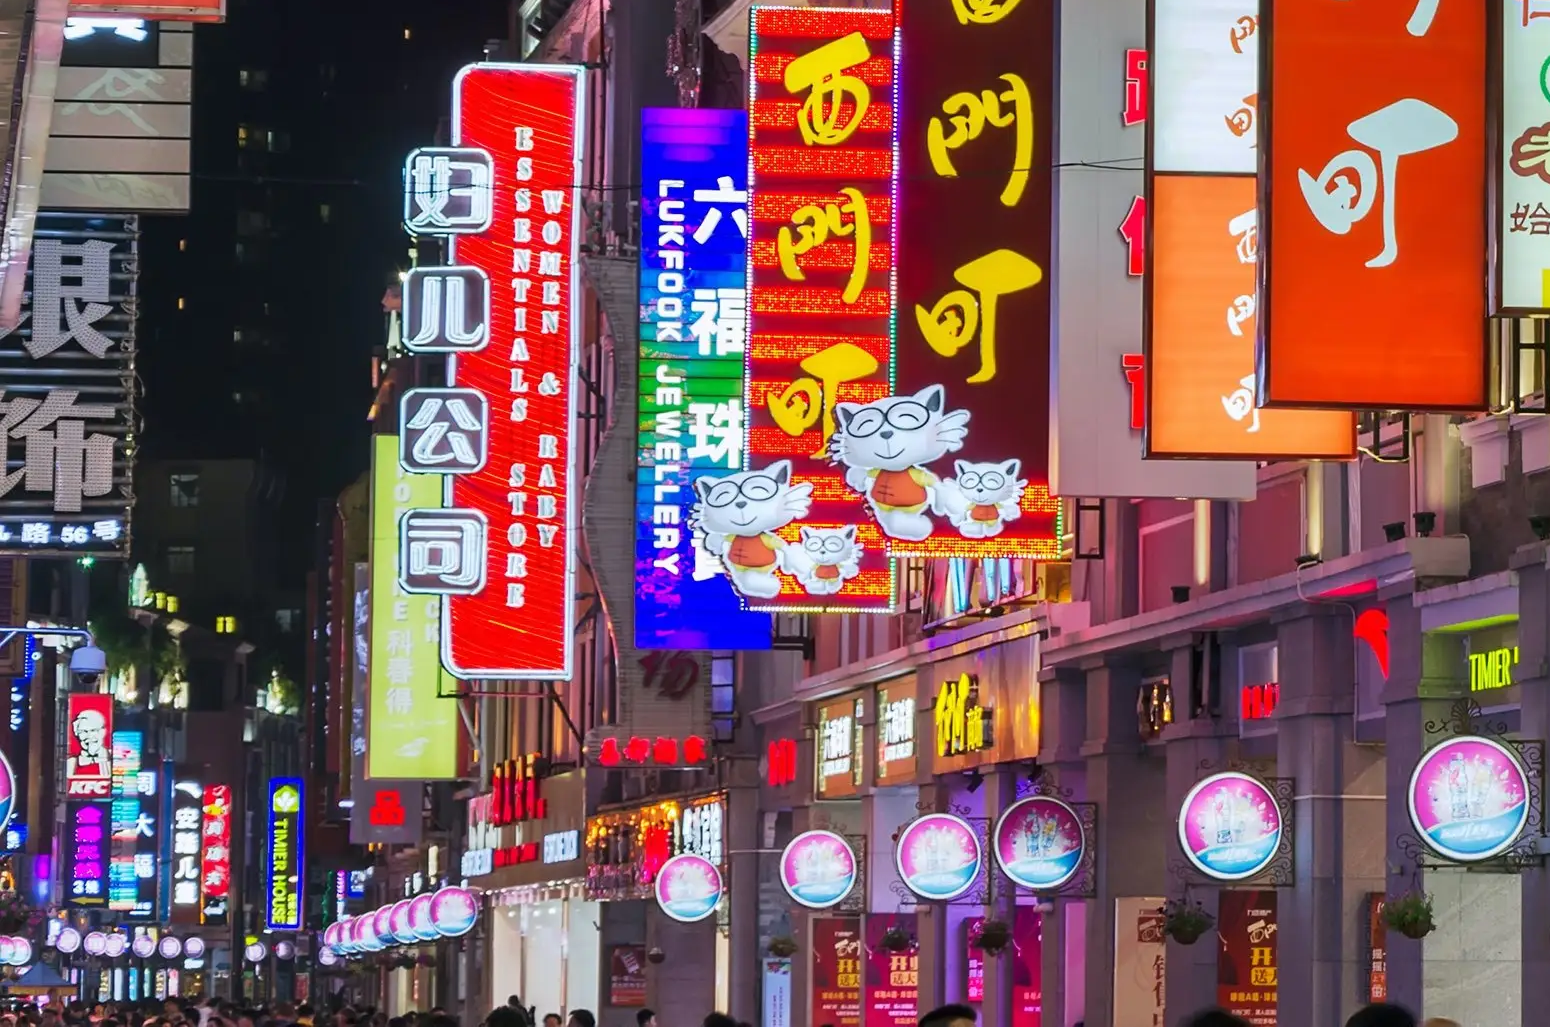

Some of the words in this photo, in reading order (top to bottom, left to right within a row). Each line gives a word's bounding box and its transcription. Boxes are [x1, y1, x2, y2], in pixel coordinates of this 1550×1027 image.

[508, 126, 535, 423] ESSENTIALS
[538, 190, 565, 334] WOMEN
[655, 179, 685, 342] LUKFOOK
[405, 154, 492, 587] 妇儿公司
[687, 176, 747, 582] 六福珠
[503, 462, 530, 608] STORE
[652, 365, 681, 576] JEWELLERY
[68, 780, 109, 794] KFC
[272, 818, 289, 872] TIMIER
[271, 874, 288, 924] HOUSE
